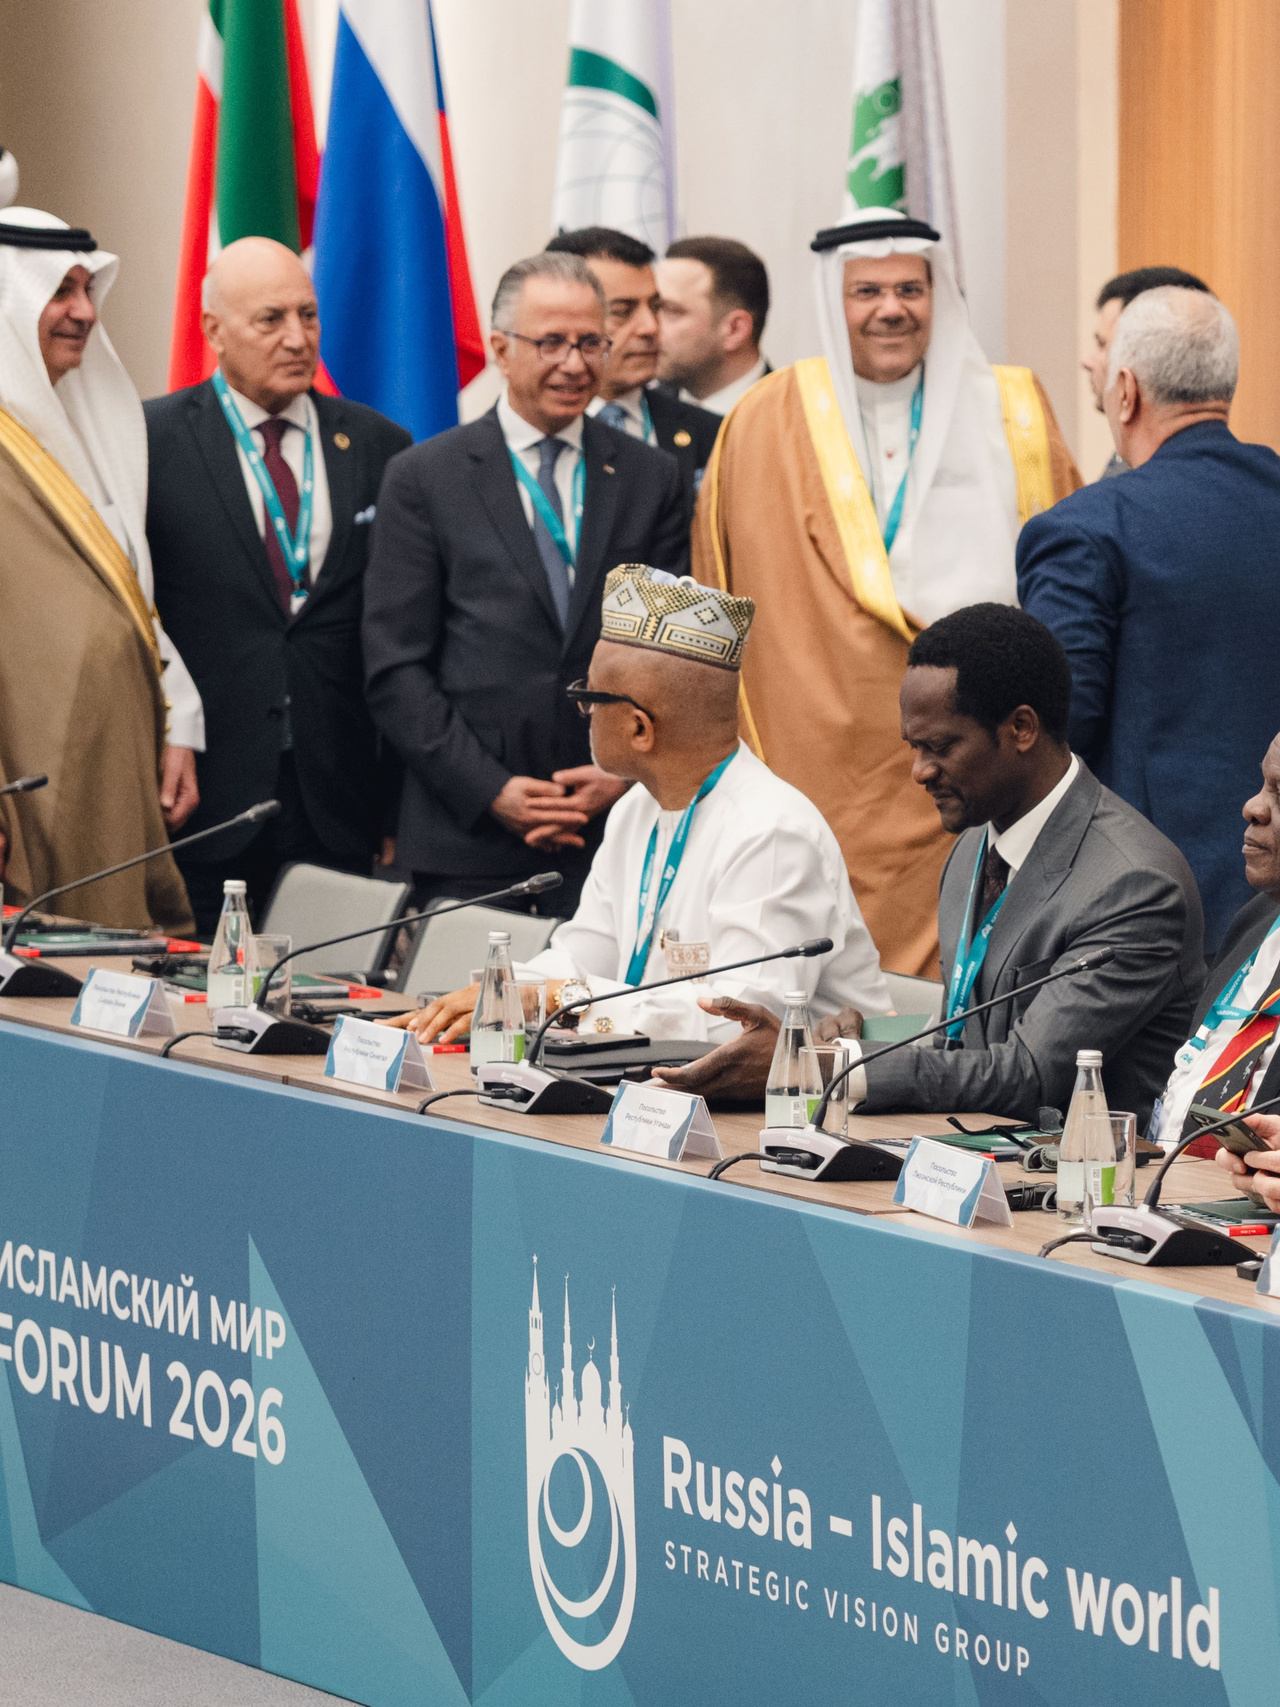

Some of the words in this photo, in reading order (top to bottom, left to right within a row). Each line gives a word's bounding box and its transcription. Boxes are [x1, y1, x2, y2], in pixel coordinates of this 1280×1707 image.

[624, 1112, 653, 1125] Республики
[652, 1119, 672, 1130] Уганды
[639, 1103, 667, 1116] Посольство
[930, 1162, 957, 1177] Посольство
[937, 1178, 967, 1194] Республики
[210, 1294, 287, 1361] МИР
[166, 1360, 287, 1467] 2026
[662, 1434, 813, 1551] Russia
[871, 1493, 1050, 1619] Islamic
[1065, 1566, 1223, 1671] world
[664, 1540, 810, 1611] STRATEGIC
[823, 1587, 919, 1645] VISION
[934, 1622, 1031, 1677] GROUP
